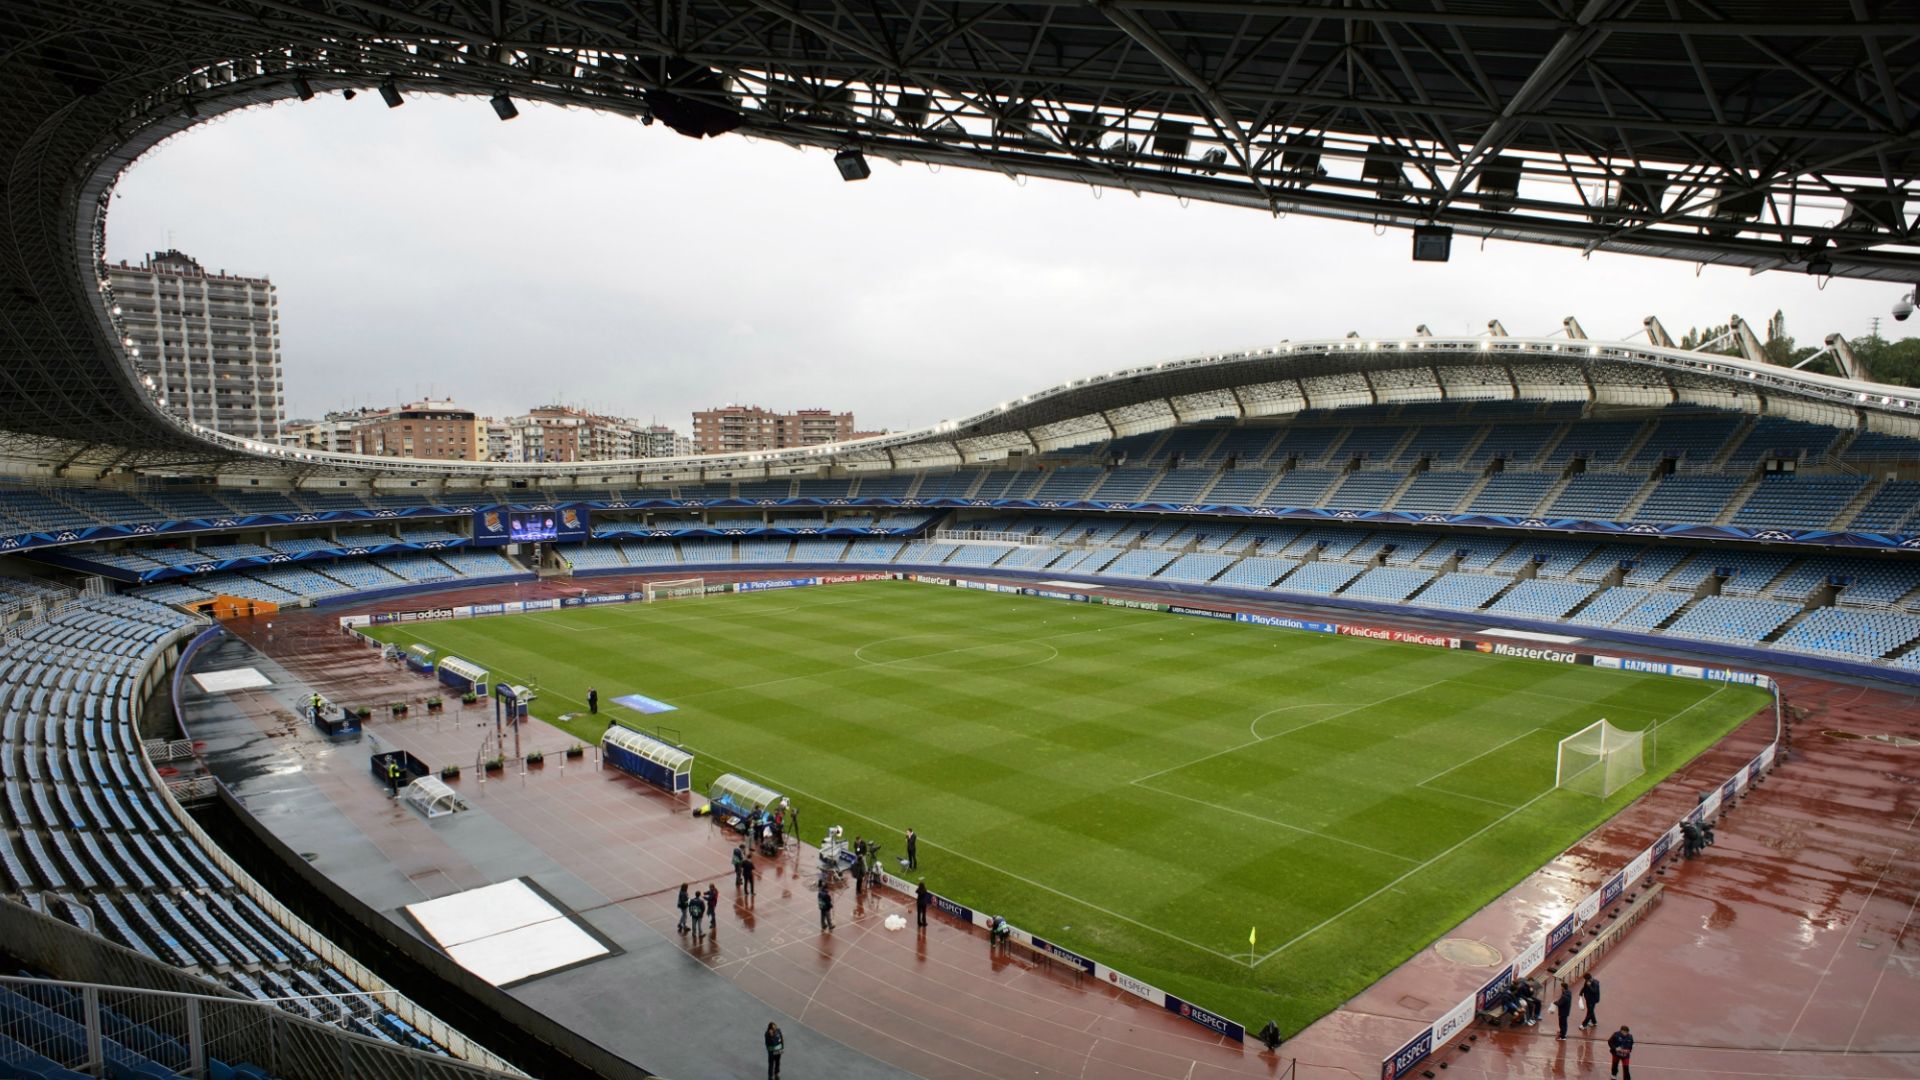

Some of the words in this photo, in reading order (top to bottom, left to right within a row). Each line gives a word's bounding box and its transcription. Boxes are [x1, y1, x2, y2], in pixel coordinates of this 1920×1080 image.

[751, 579, 792, 590] PlayStation
[917, 575, 950, 586] MasterCard
[707, 585, 724, 593] world
[1140, 601, 1158, 611] world
[1172, 606, 1184, 614] UEFA
[1185, 608, 1212, 617] CHAMPIONS
[1213, 611, 1232, 619] LEAGUE
[417, 609, 452, 619] adidas
[1252, 615, 1302, 629] PlayStation
[1350, 626, 1390, 640] UniCredit
[1403, 633, 1445, 647] UniCredit
[1494, 643, 1576, 664] MasterCard
[1624, 660, 1667, 674] GAZPROM
[1708, 669, 1754, 684] GAZPROM
[889, 877, 910, 892] RESPECT
[939, 899, 962, 917] RESPECT
[1053, 949, 1082, 967] RESPECT
[1521, 946, 1543, 972] RESPECT
[1118, 977, 1151, 997] RESPECT
[1191, 1008, 1228, 1031] RESPECT
[1396, 1036, 1431, 1072] RESPECT
